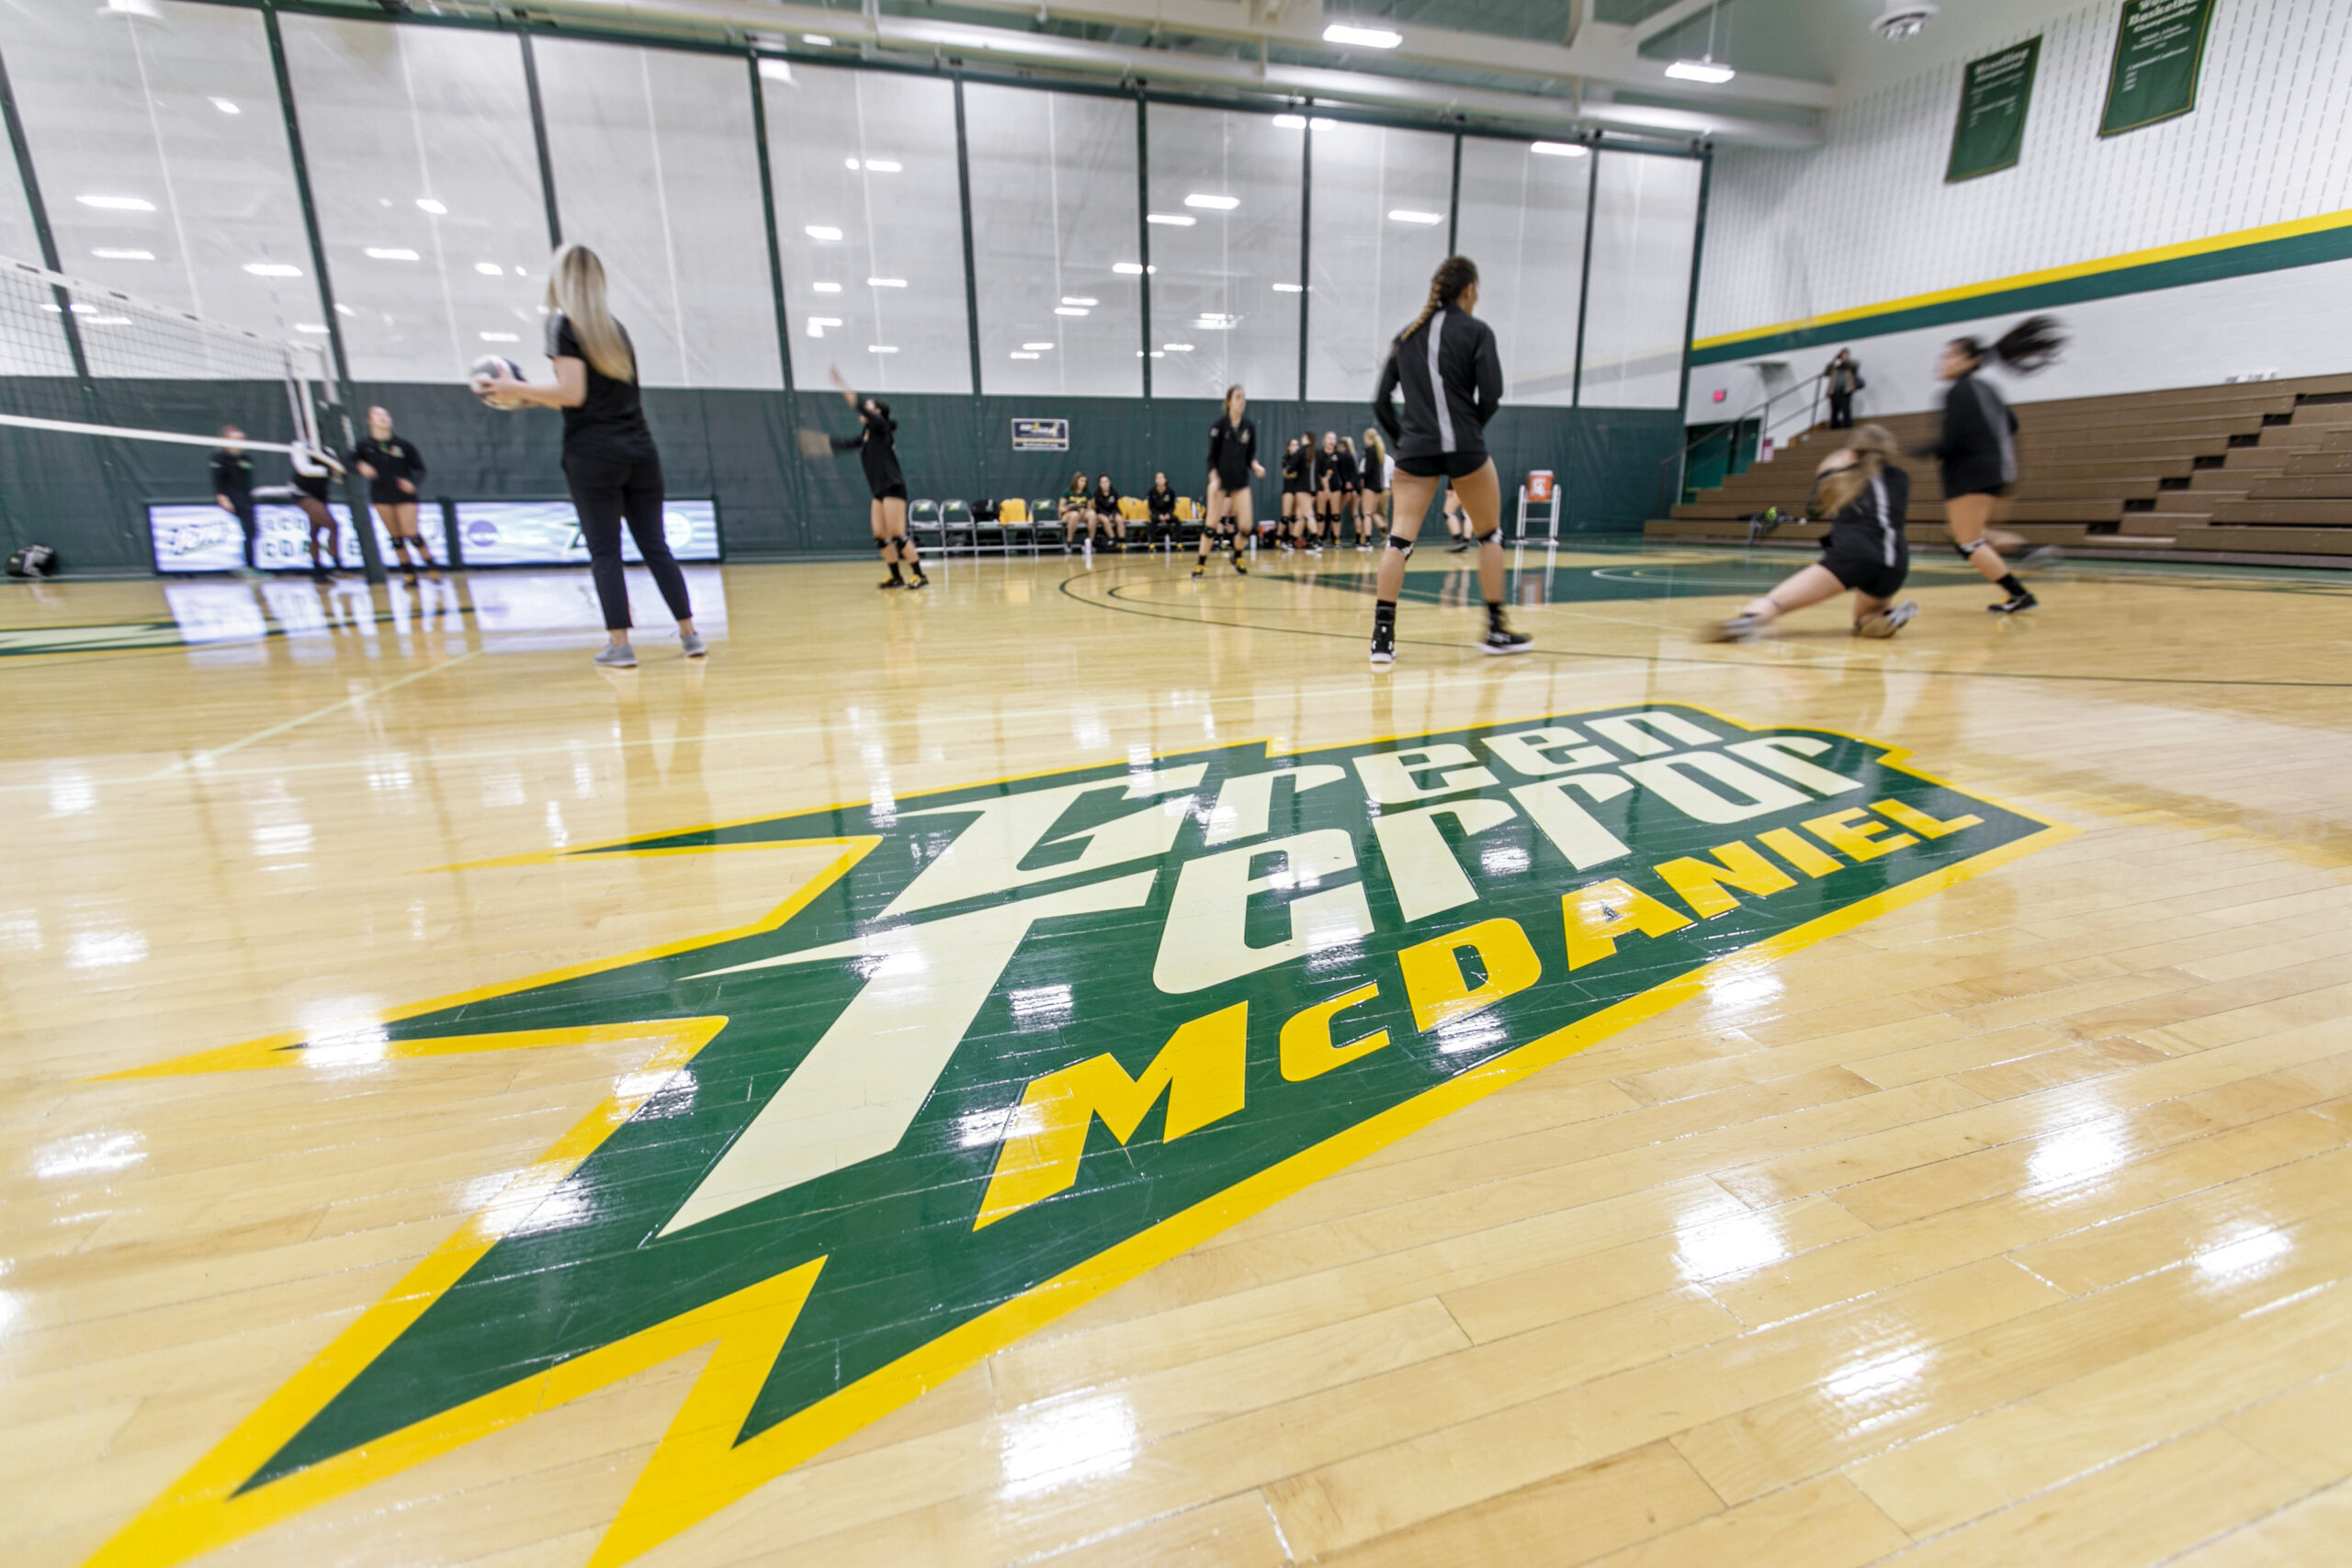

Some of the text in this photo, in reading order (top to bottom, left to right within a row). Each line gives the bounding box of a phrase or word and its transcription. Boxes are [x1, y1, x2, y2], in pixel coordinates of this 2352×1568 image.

[655, 736, 1865, 1238] Terror
[875, 711, 1723, 919] Green
[973, 798, 1984, 1232] McDANIEL
